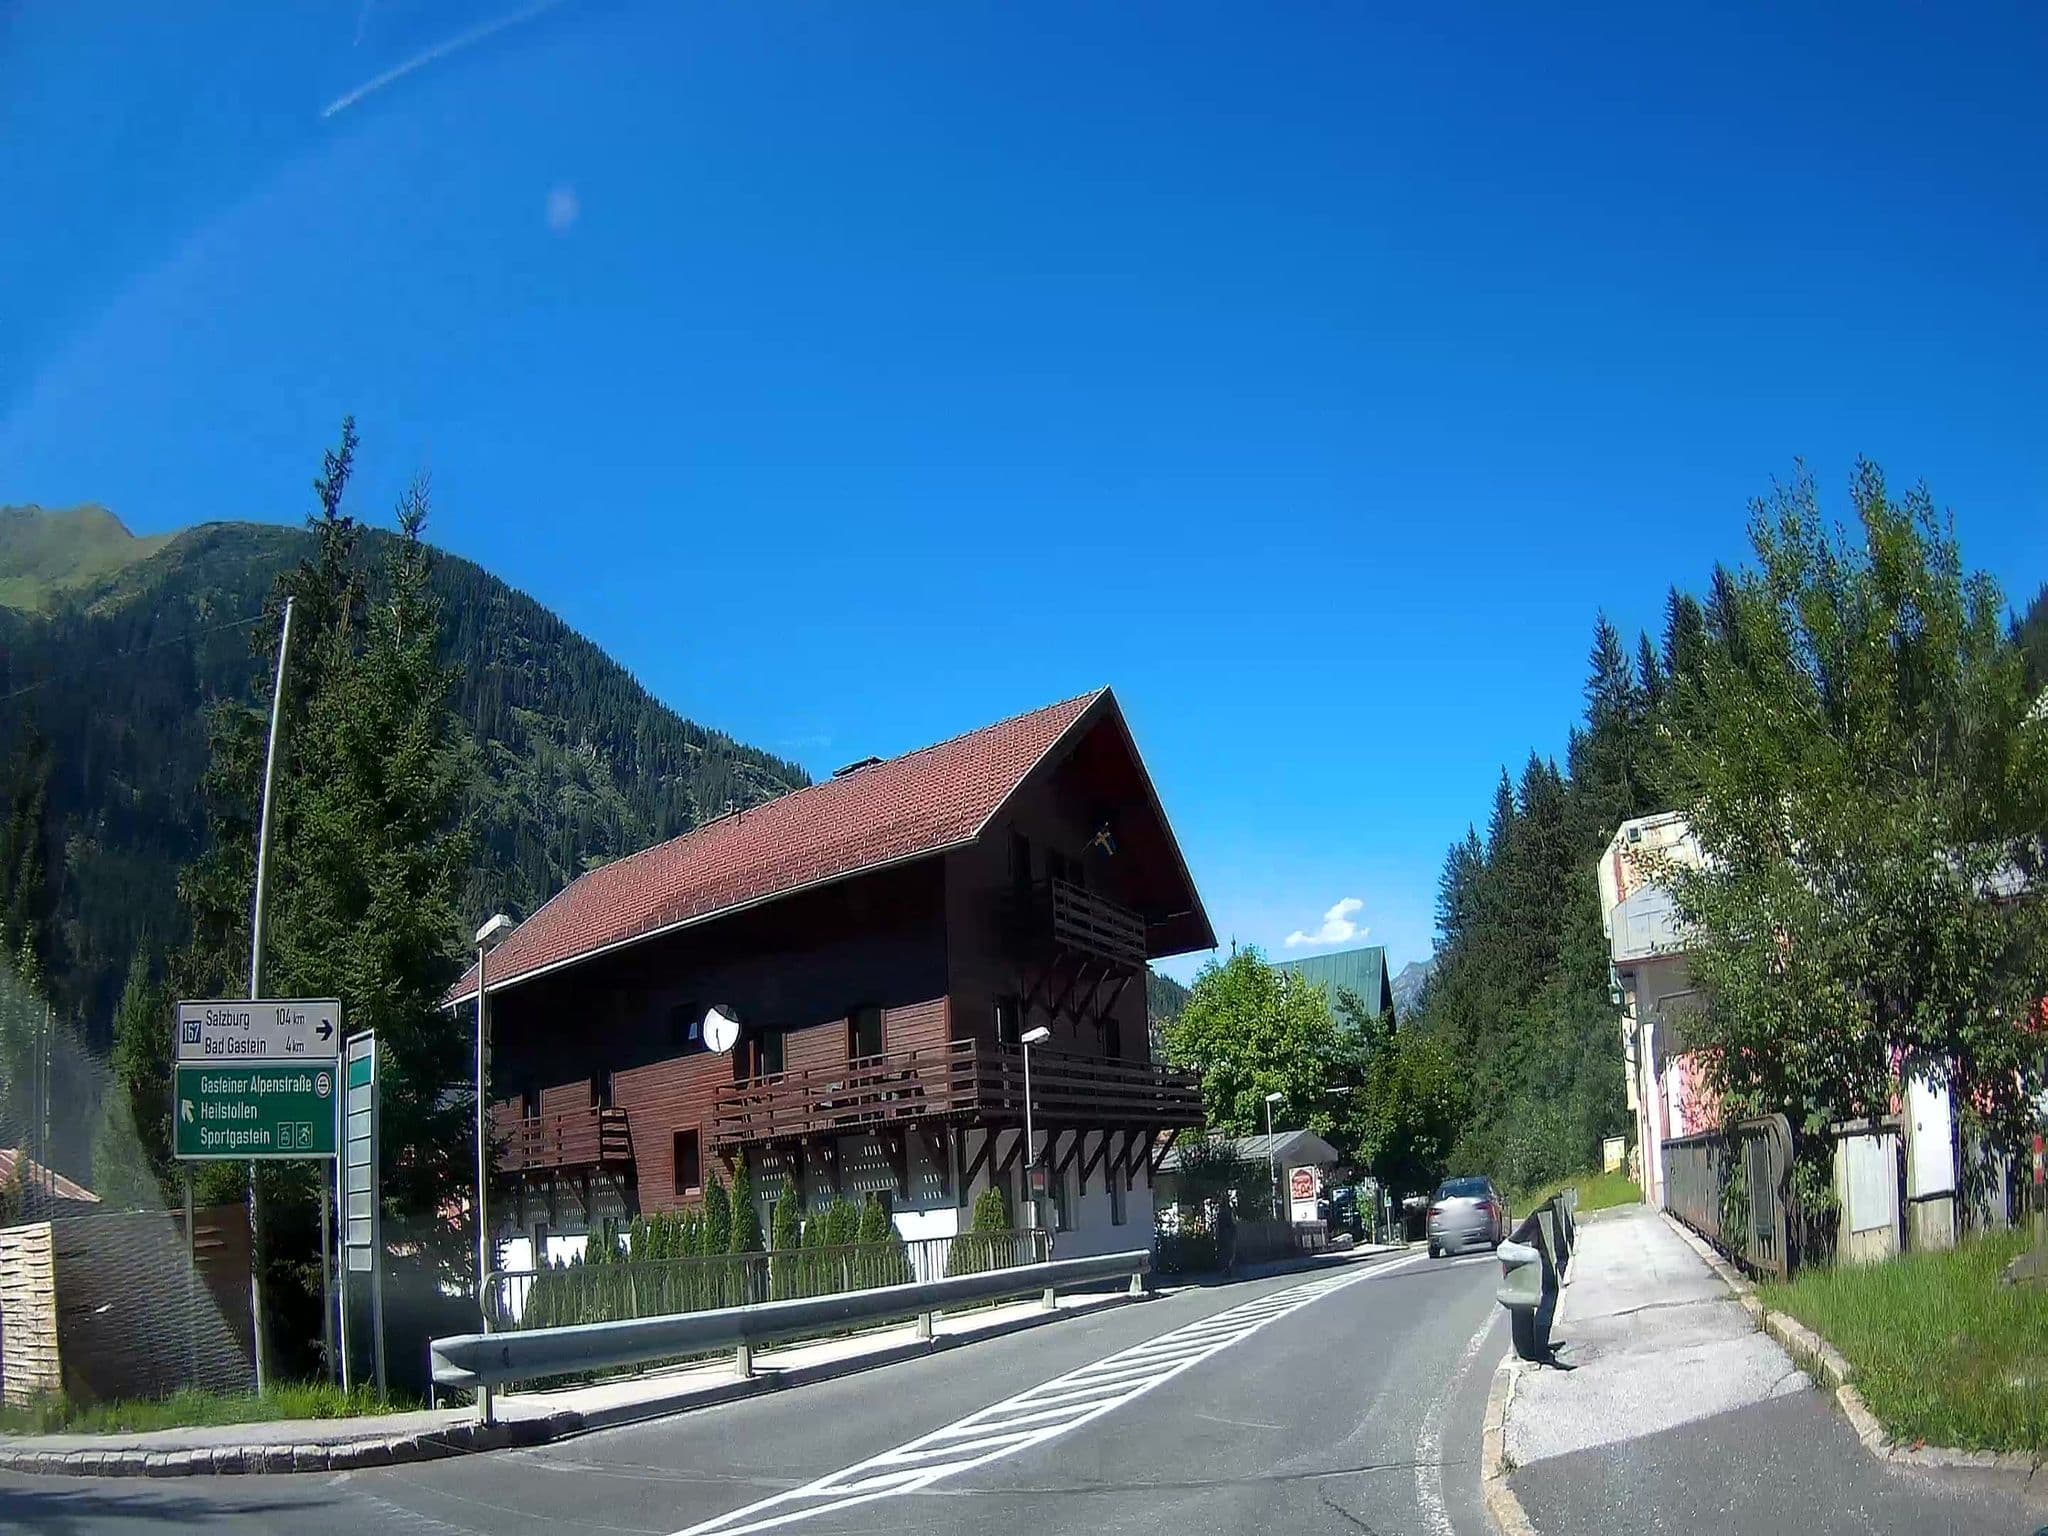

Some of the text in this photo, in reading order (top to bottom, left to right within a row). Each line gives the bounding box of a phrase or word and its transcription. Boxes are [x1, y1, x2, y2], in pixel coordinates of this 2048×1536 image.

[206, 1008, 305, 1030] Salzburg 104 km
[184, 1022, 200, 1042] 167
[205, 1036, 305, 1054] Bad Gastein 4 km
[201, 1076, 248, 1094] Gasteiner
[250, 1075, 312, 1097] Alpenstraße
[201, 1102, 258, 1120] Heilstollen
[201, 1127, 270, 1148] Sportgastein
